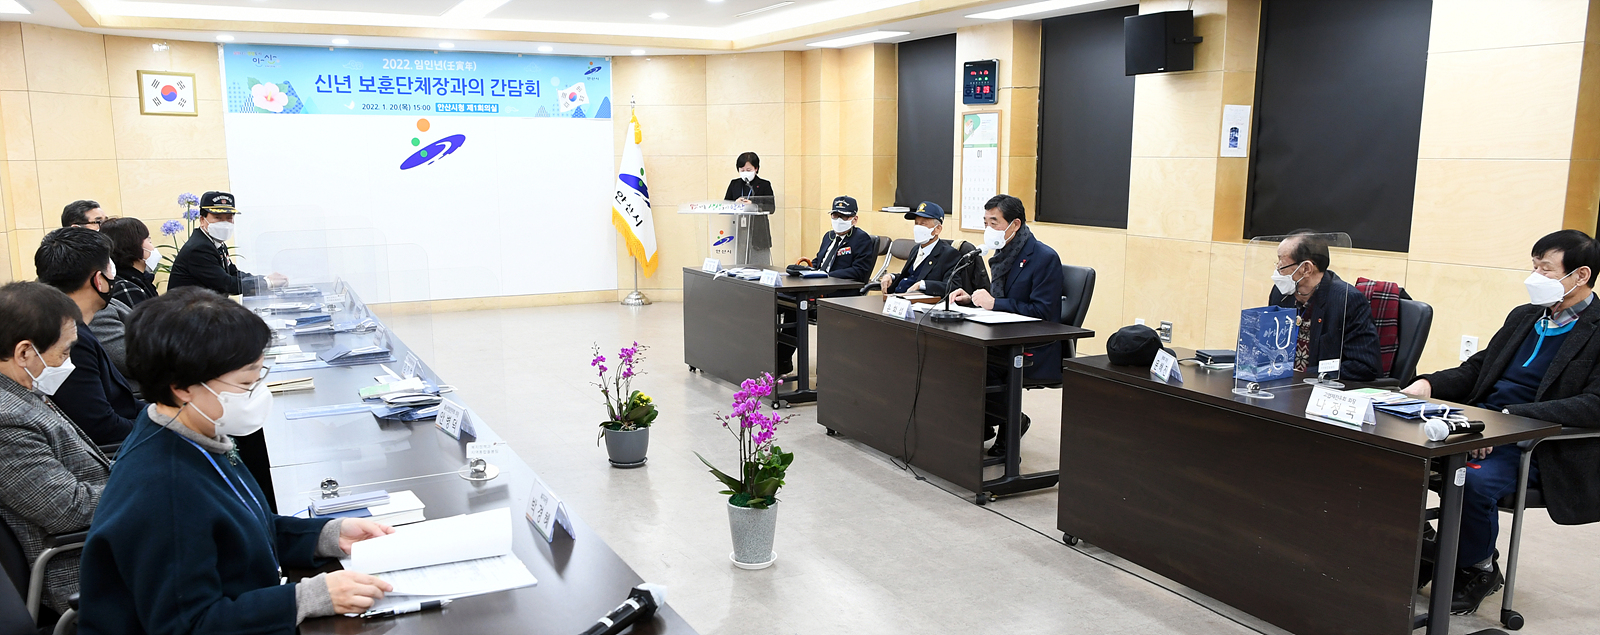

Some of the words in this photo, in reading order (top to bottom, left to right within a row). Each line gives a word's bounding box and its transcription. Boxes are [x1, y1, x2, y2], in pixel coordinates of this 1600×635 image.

[382, 58, 413, 70] 2022.
[414, 59, 477, 71] 임인년(壬寅年)
[315, 74, 352, 94] 신년
[358, 75, 485, 97] 보훈단체장과의
[490, 78, 541, 98] 간담회
[362, 103, 380, 111] 2022.
[437, 103, 465, 112] 안산시청
[615, 190, 643, 227] 안산시
[1316, 398, 1357, 420] 나정국
